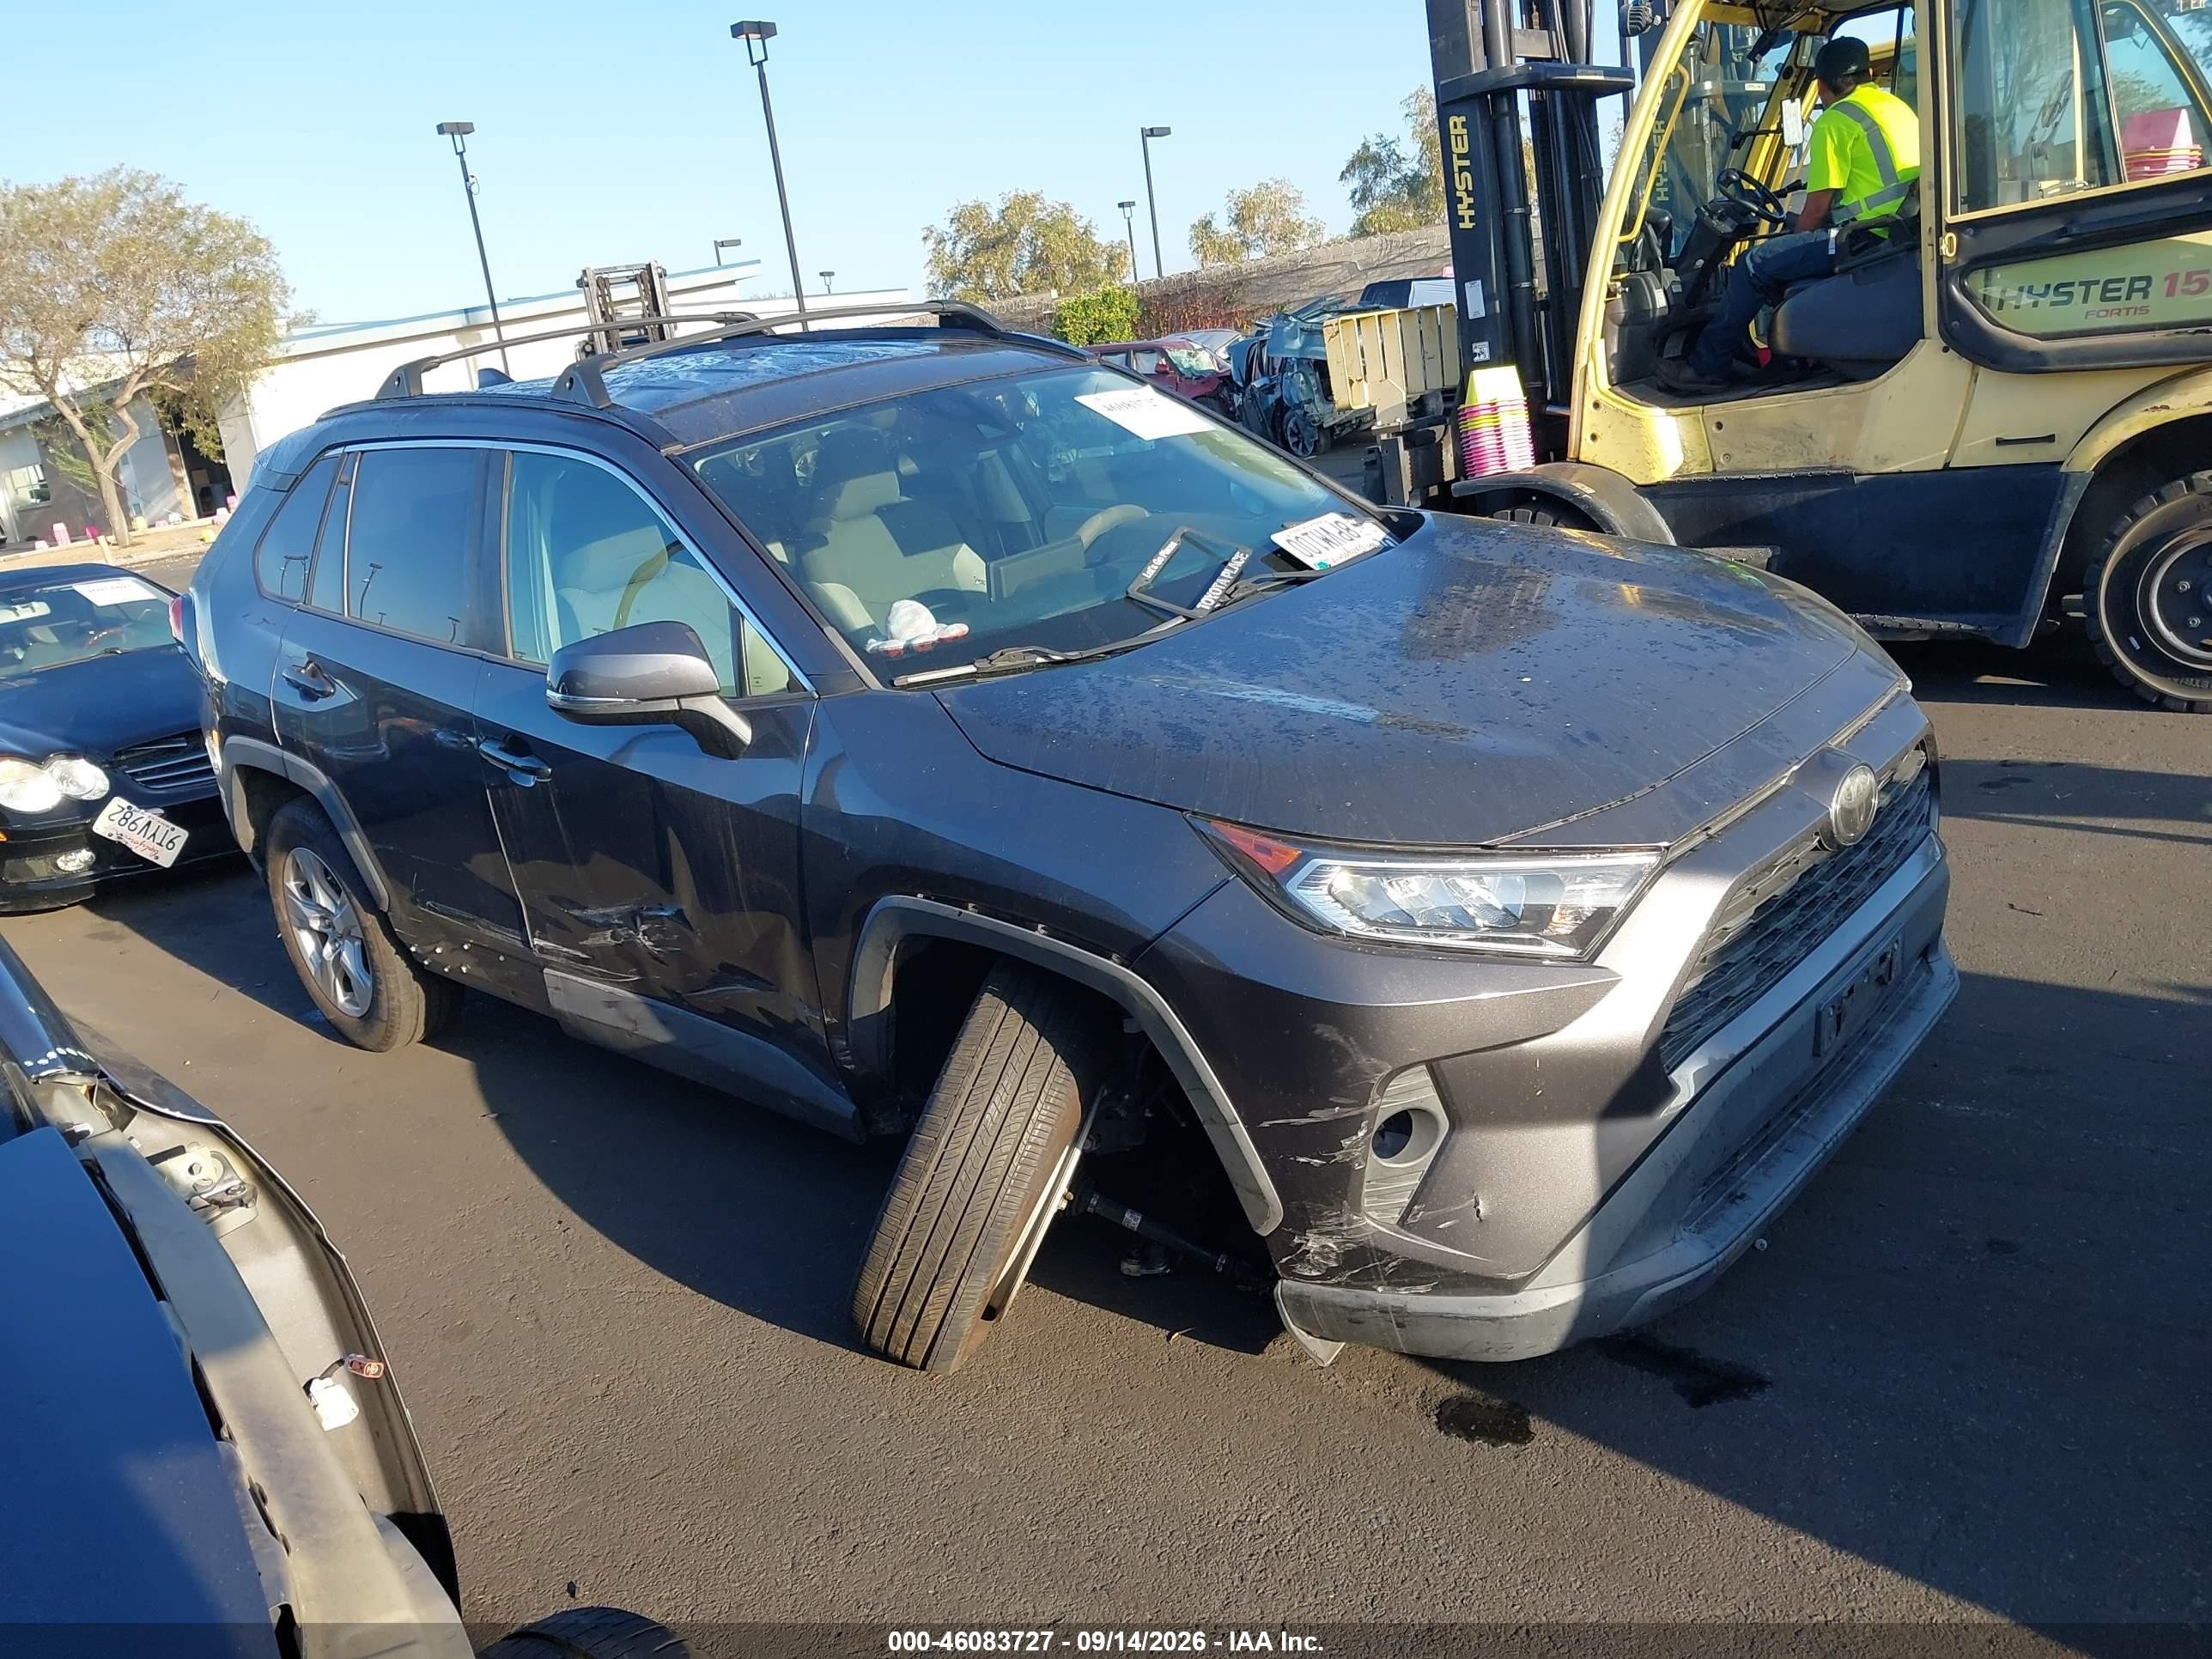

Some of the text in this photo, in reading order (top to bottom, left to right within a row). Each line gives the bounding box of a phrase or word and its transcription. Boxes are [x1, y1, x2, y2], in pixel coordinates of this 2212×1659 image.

[1449, 115, 1476, 228] HYSTER
[1997, 275, 2153, 311] HYSTER
[2085, 305, 2150, 319] FORTIS
[1286, 520, 1360, 557] 8PVM100
[1196, 550, 1249, 610] TOYOTA PLACE
[108, 805, 181, 850] 9TYV982
